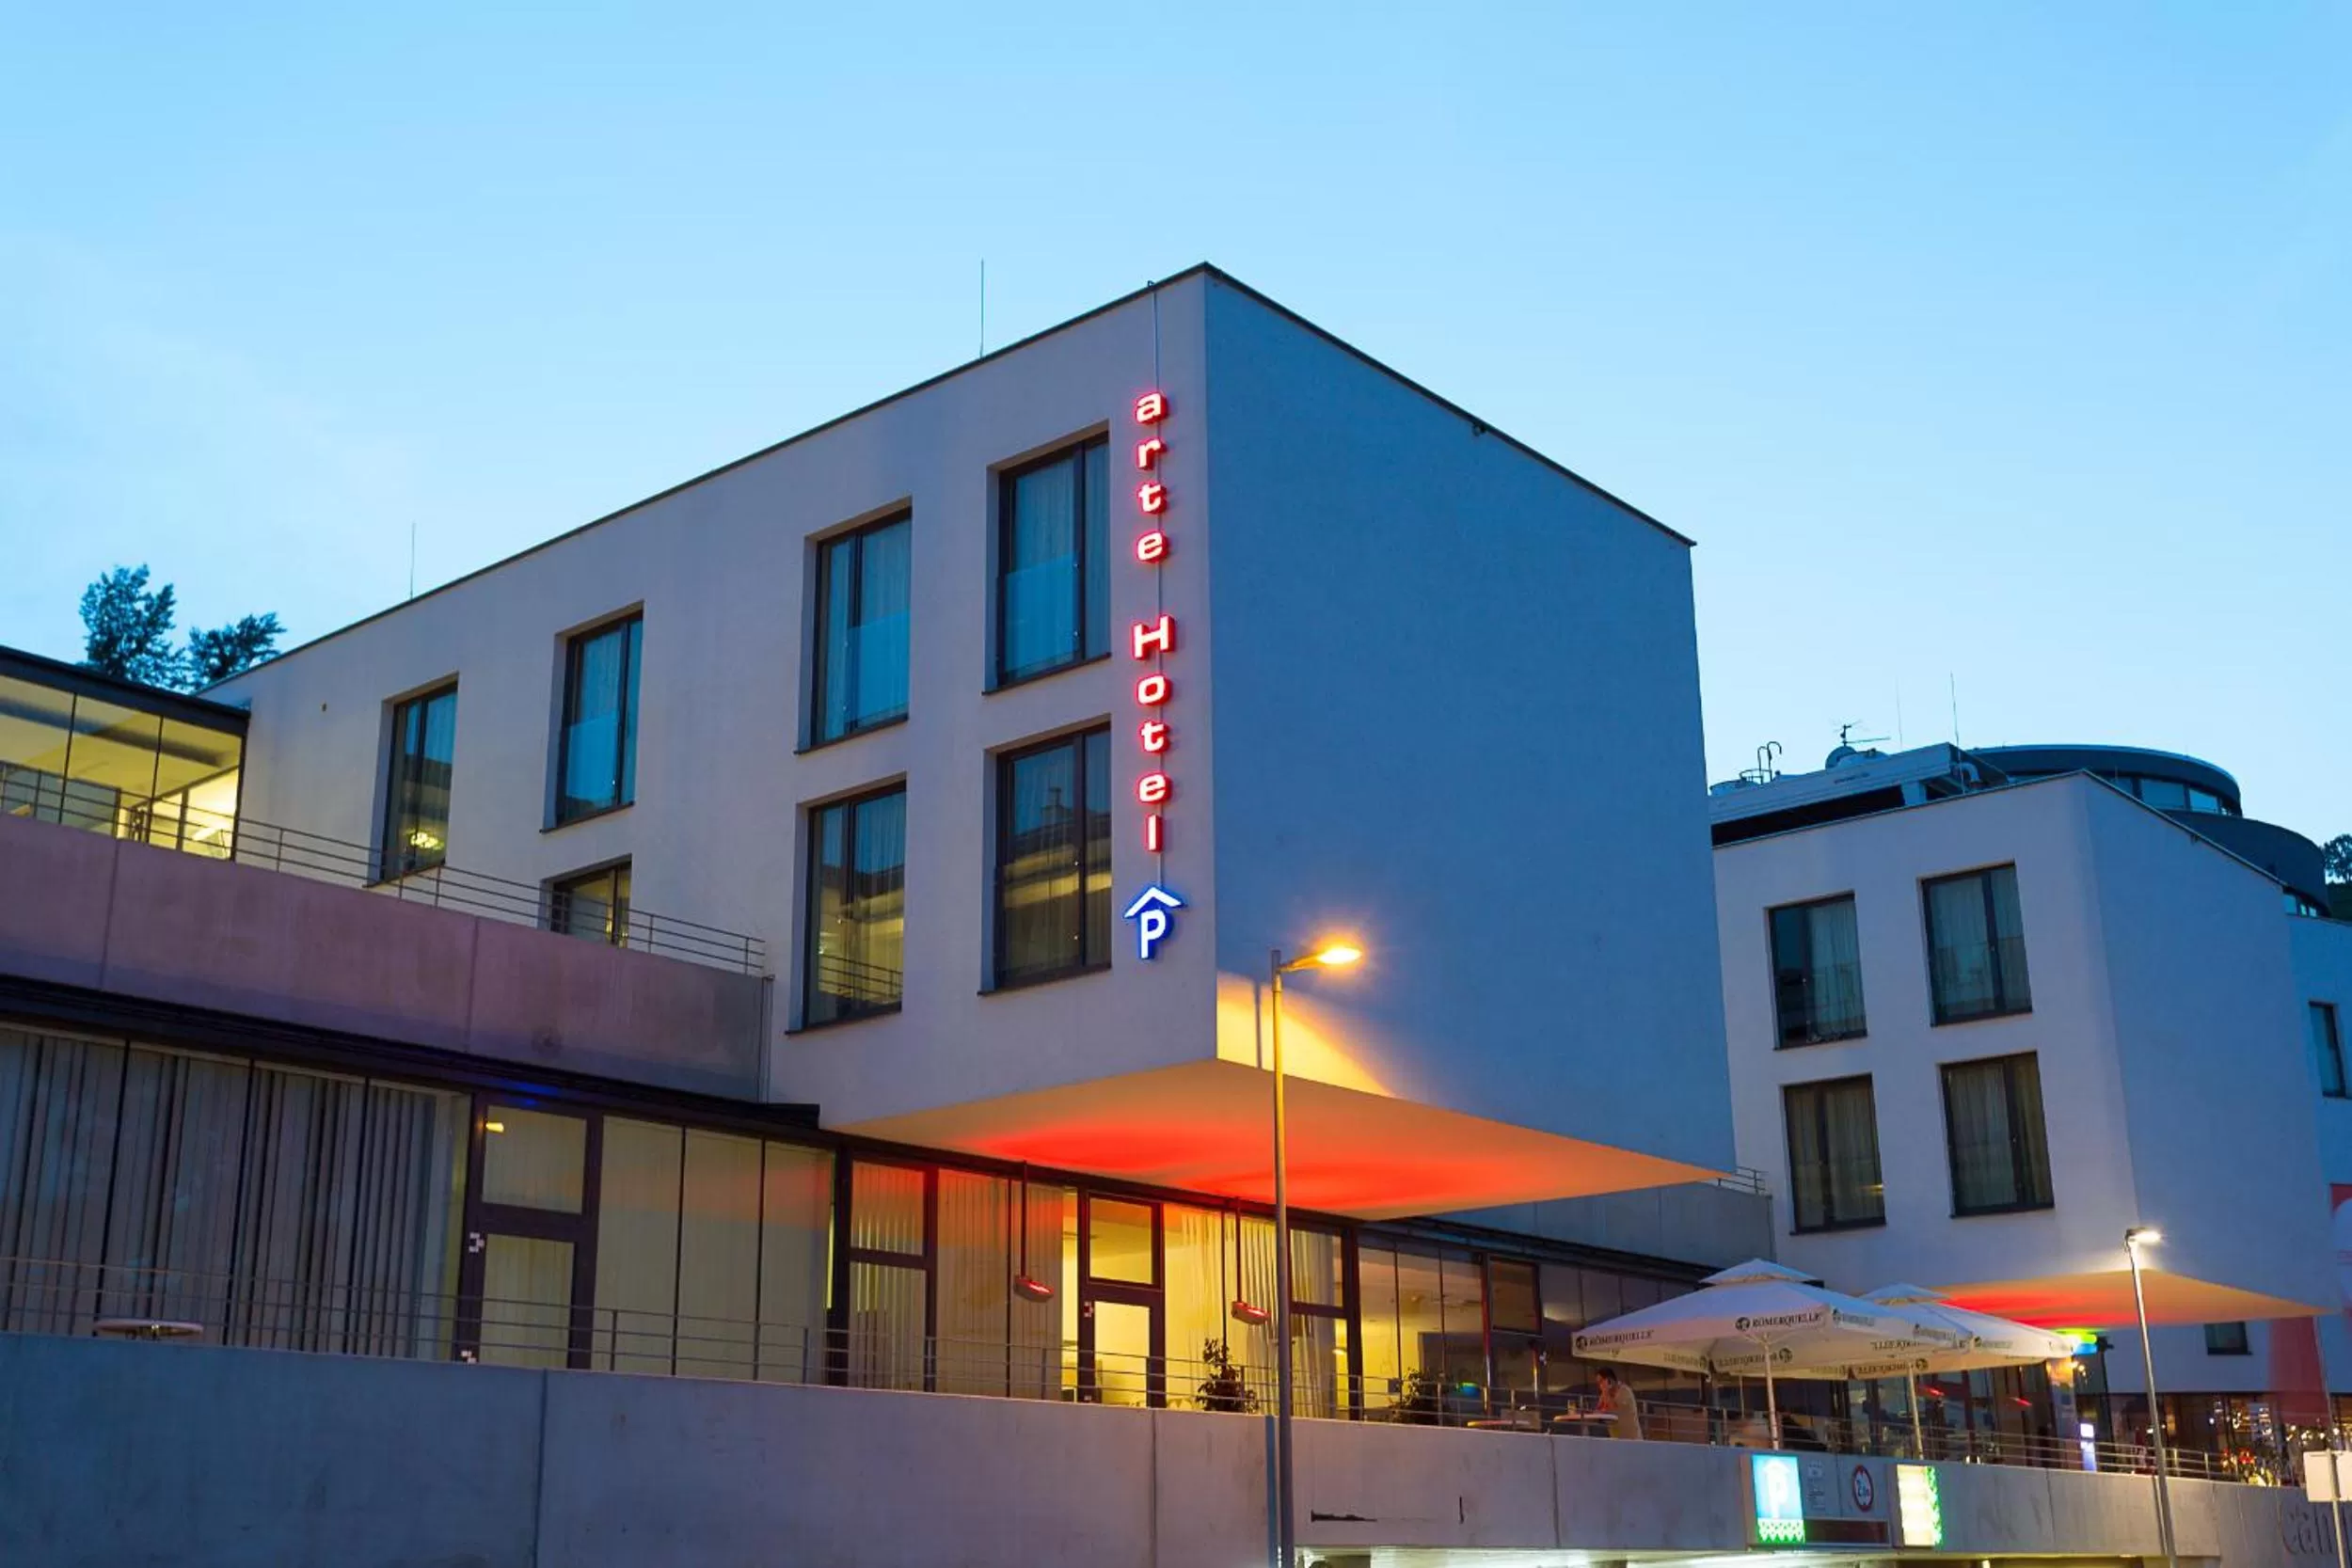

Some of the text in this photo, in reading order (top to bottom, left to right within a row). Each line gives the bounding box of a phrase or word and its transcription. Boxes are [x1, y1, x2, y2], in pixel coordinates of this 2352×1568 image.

[1133, 391, 1175, 852] arte Hotel
[1140, 908, 1167, 959] P
